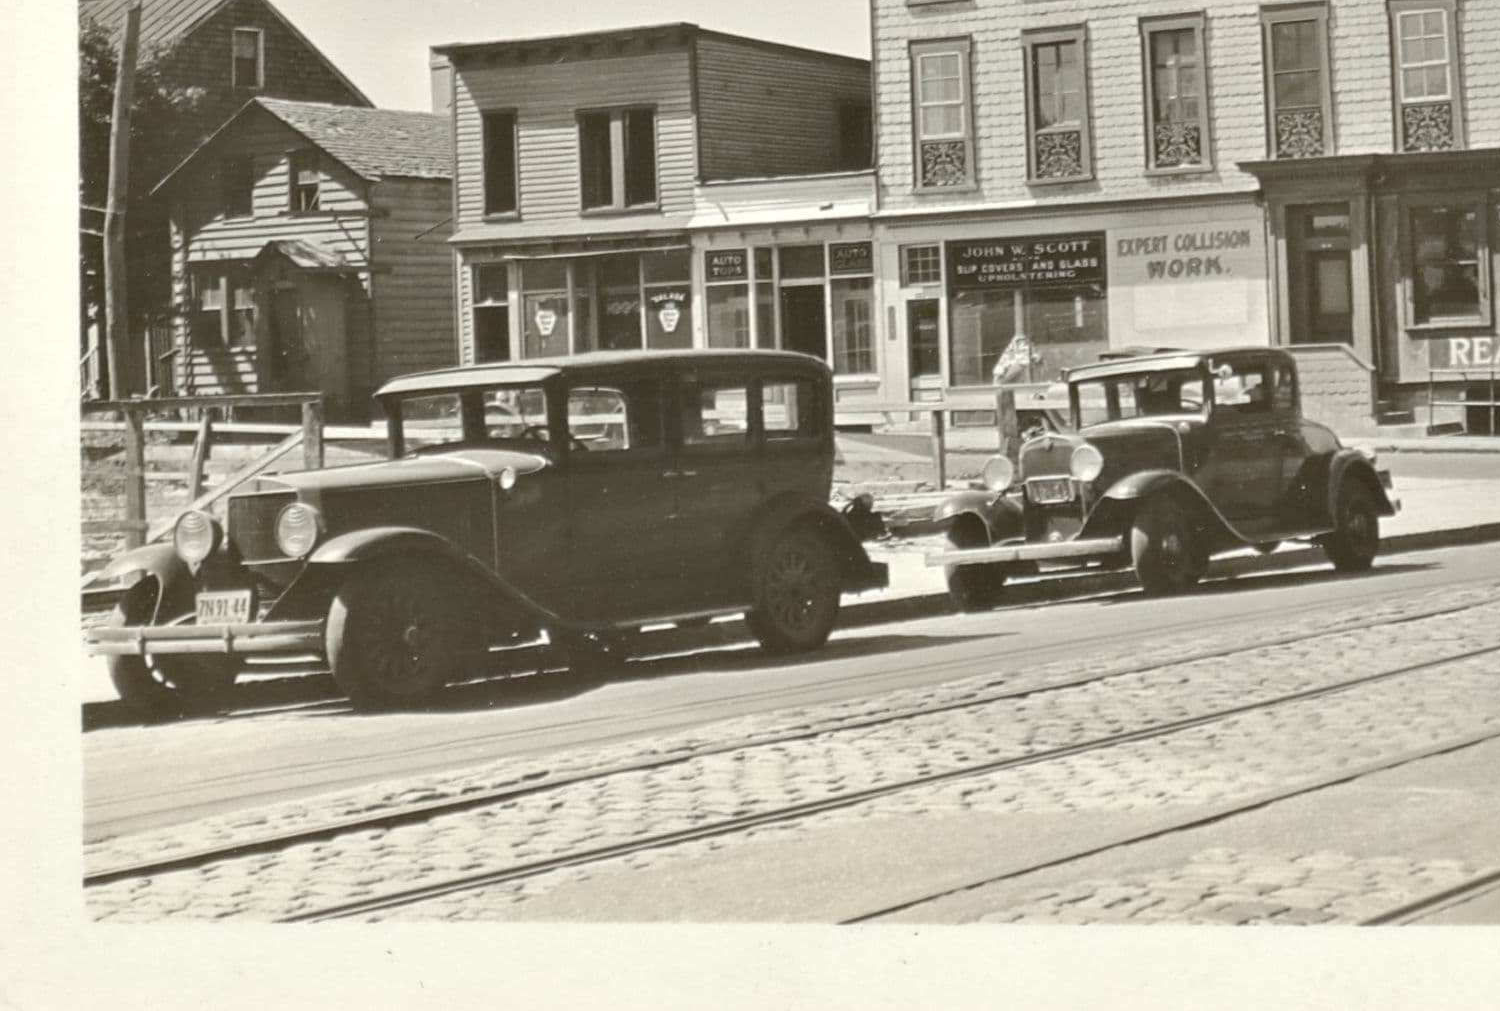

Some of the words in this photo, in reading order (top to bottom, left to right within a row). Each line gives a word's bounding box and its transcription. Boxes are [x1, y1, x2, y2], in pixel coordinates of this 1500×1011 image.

[962, 247, 1005, 259] JOHN
[1011, 245, 1027, 256] W.
[1034, 240, 1091, 255] SCOTT
[1117, 235, 1169, 258] EXPERT
[1173, 229, 1251, 253] COLLISION
[711, 255, 742, 267] AUTO
[981, 262, 1024, 274] COVERS
[1032, 260, 1055, 271] AND
[1147, 255, 1232, 279] WORK.
[977, 270, 1076, 283] UPHOLSTERING
